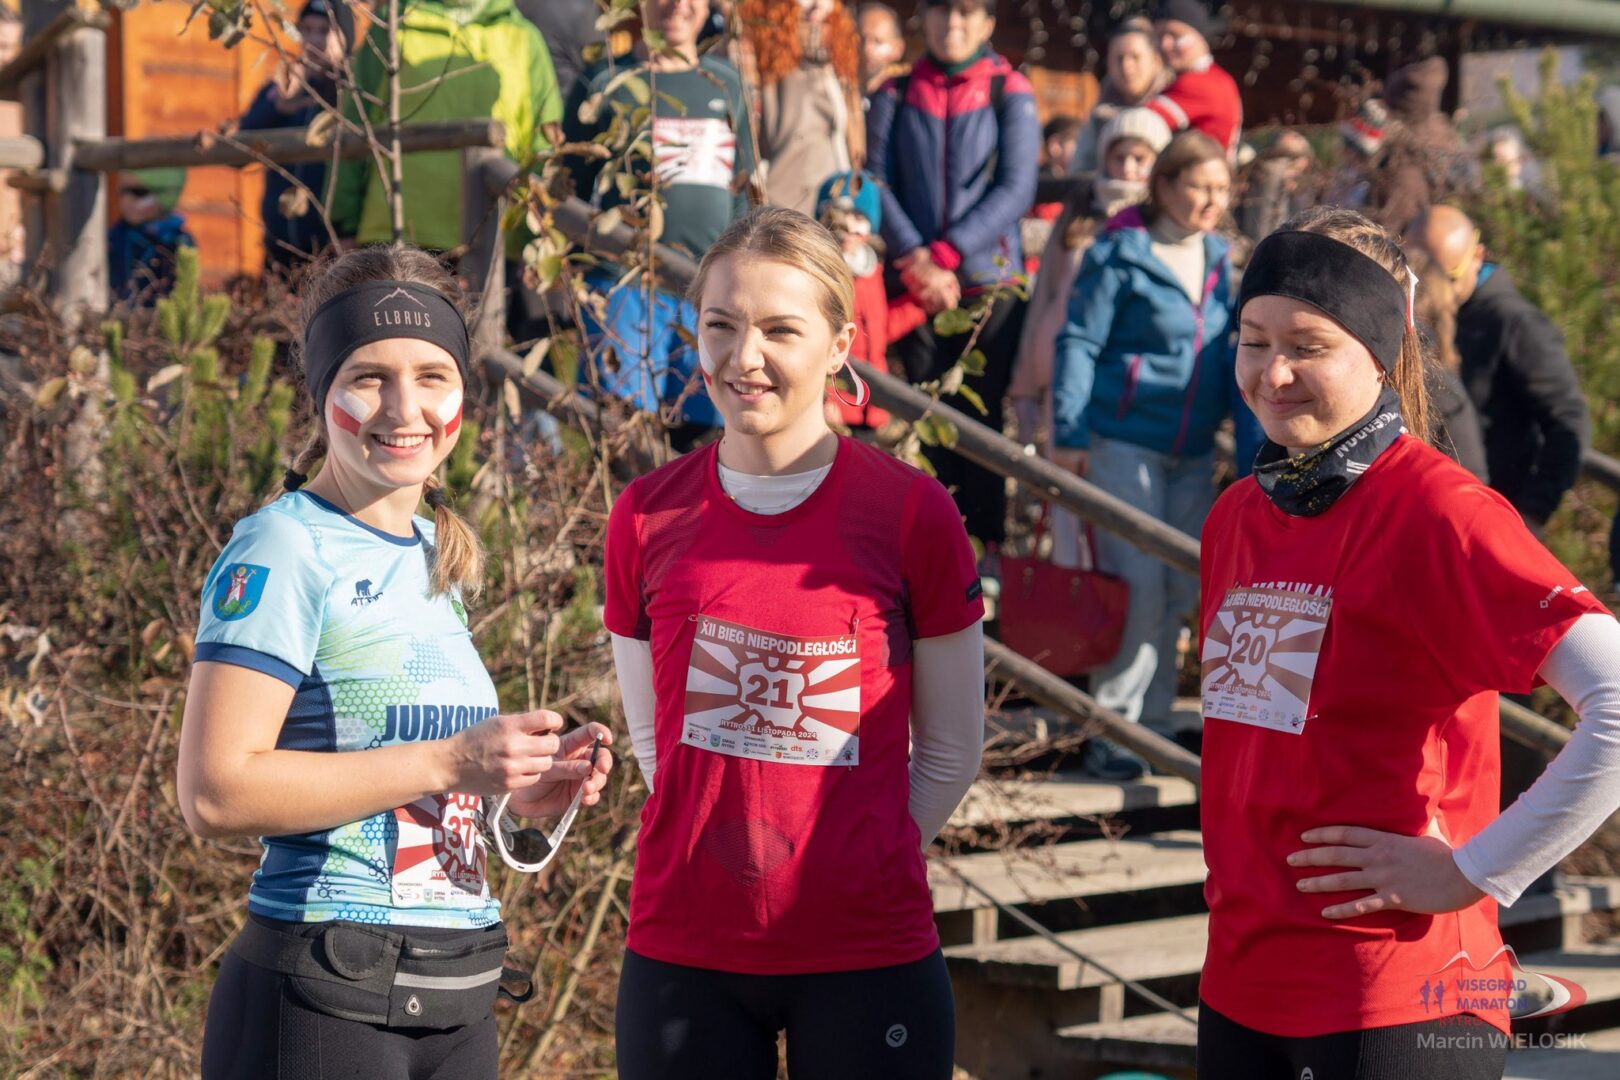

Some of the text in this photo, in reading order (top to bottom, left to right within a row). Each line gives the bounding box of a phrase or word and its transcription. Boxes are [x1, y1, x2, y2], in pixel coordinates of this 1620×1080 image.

[374, 310, 431, 328] ELBRUS
[701, 619, 857, 657] XII BIEG NIEPODLEGŁOŚCI
[1231, 632, 1267, 666] 20
[745, 674, 794, 710] 21
[380, 705, 498, 742] JURKO
[757, 726, 797, 737] LISTOPADA
[798, 731, 817, 739] 2024
[448, 815, 472, 850] 37
